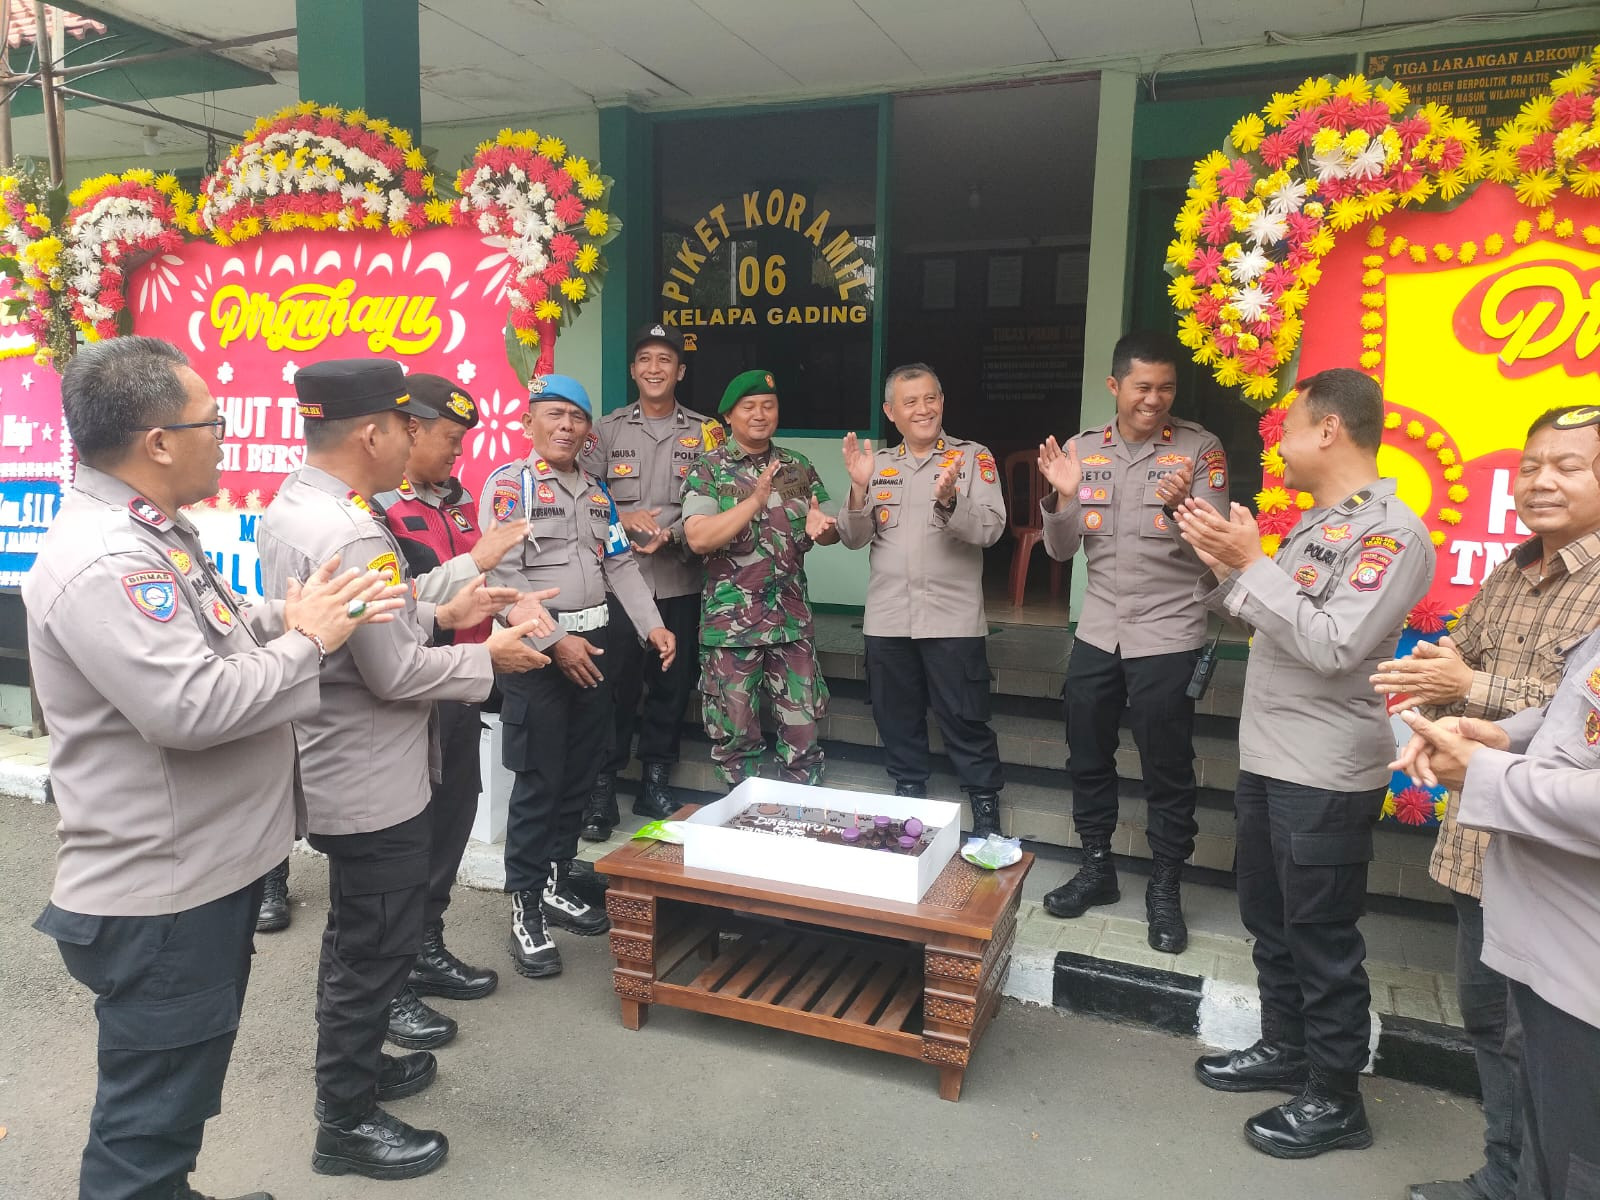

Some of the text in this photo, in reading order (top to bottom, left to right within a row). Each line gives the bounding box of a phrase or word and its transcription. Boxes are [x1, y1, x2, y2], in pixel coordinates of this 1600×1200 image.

[1393, 62, 1428, 75] TIGA
[1432, 54, 1518, 72] LARANGAN
[1426, 81, 1455, 92] BOLEH
[1457, 76, 1507, 89] BERPOLITIK
[1511, 72, 1549, 85] PRAKTIS
[1456, 91, 1485, 103] MASUK
[1490, 87, 1527, 100] WILAYAH
[1457, 104, 1487, 116] HUKUM
[661, 203, 730, 304] PIKET
[743, 188, 869, 300] KORAMIL
[738, 255, 786, 296] 06
[210, 278, 442, 355] Dirgahayu
[662, 305, 867, 326] KELAPA GADING
[216, 396, 272, 438] HUT
[1081, 470, 1112, 481] SETO
[1303, 542, 1338, 566] POLRI
[128, 573, 169, 584] BINMAS
